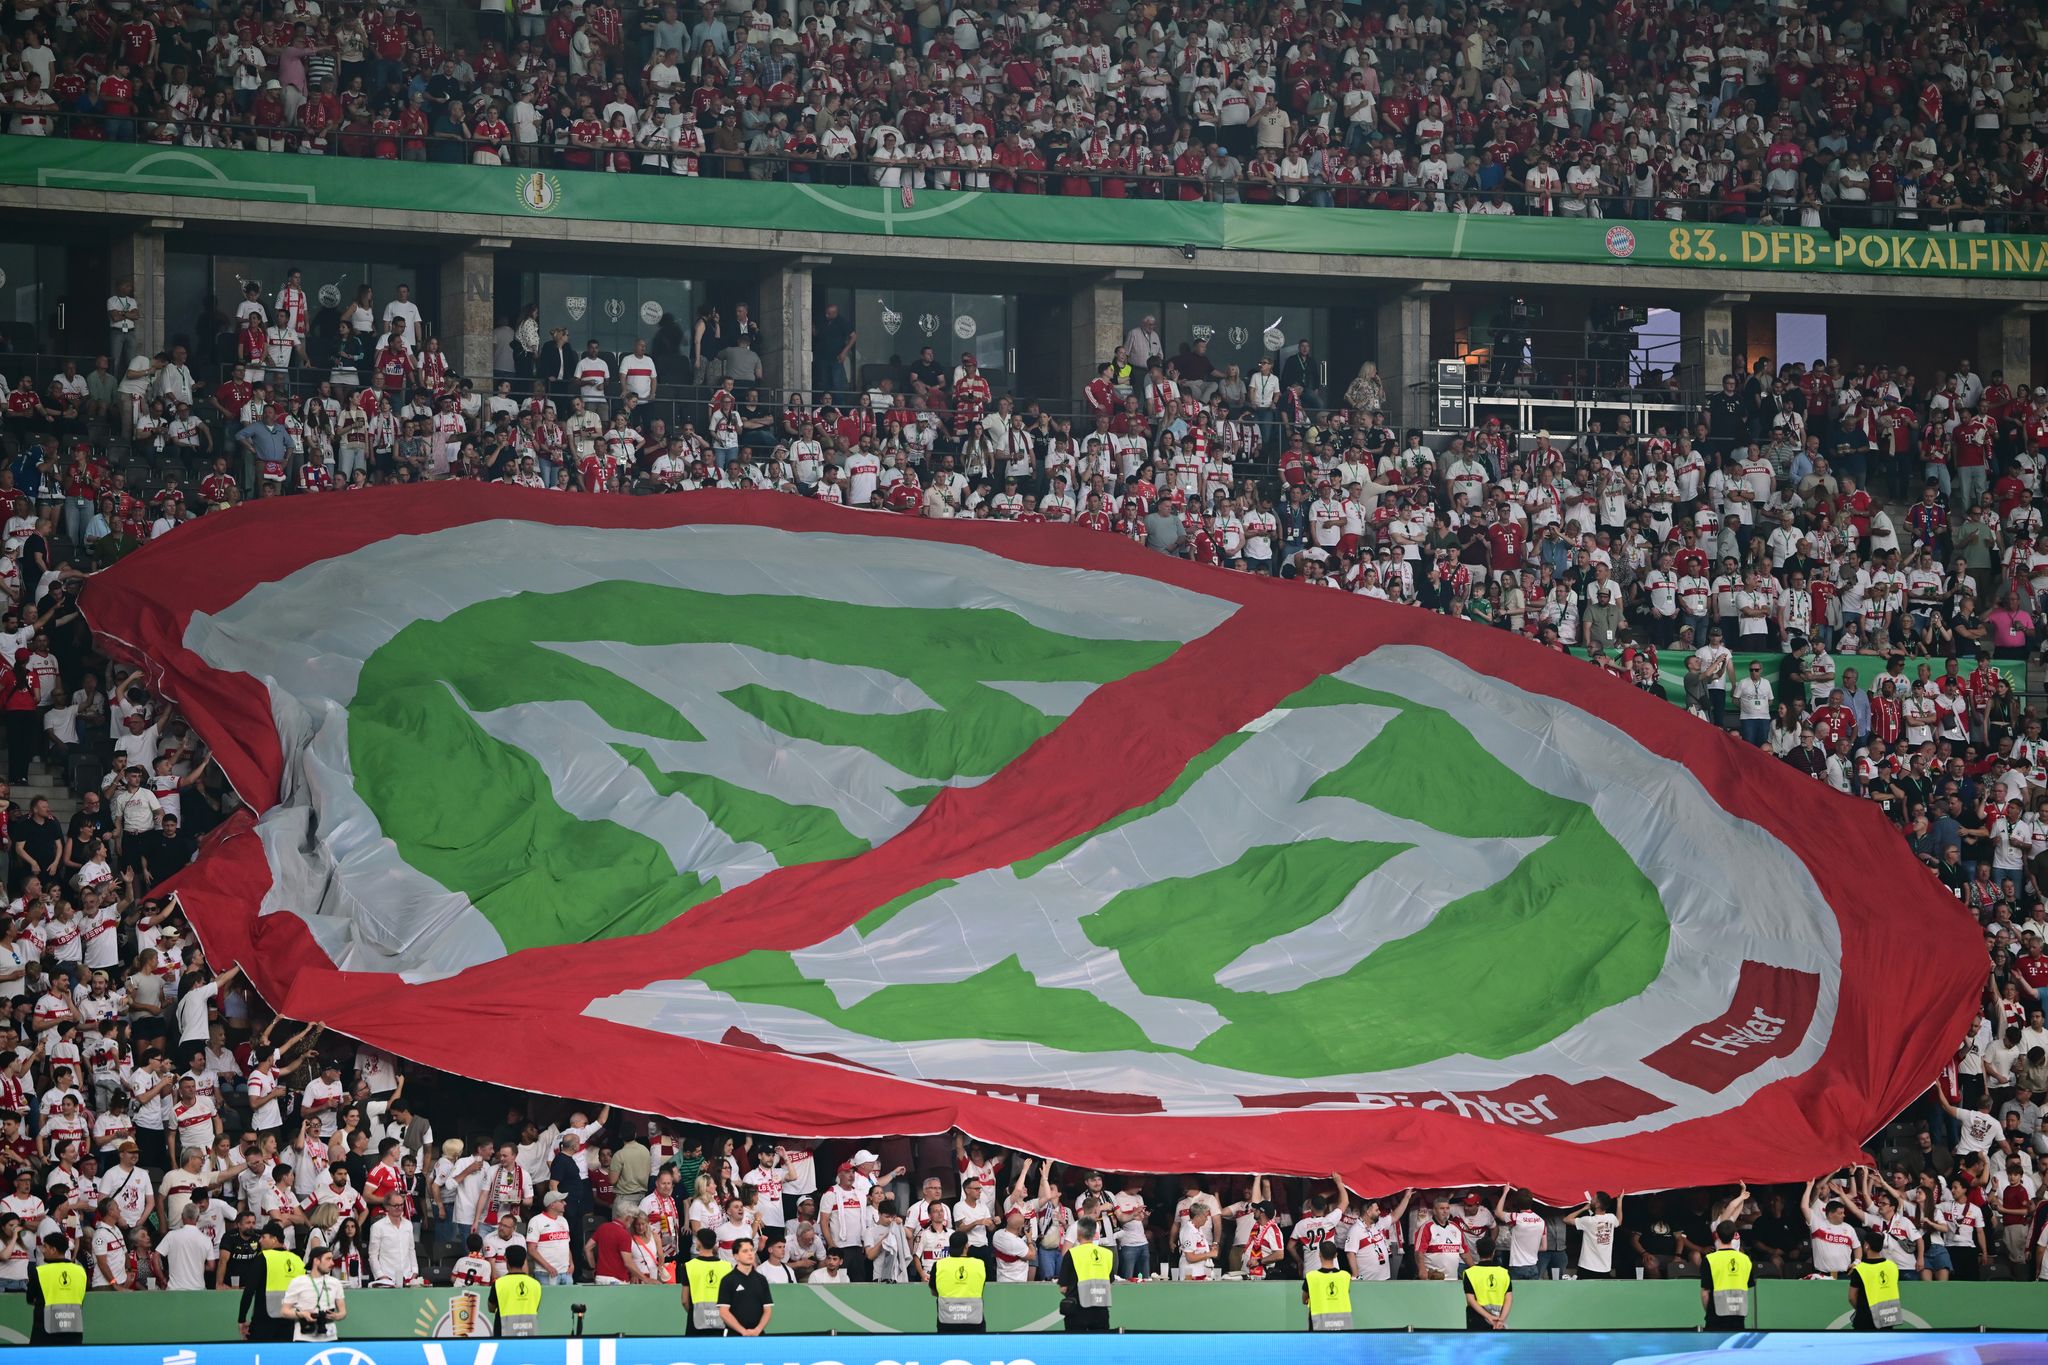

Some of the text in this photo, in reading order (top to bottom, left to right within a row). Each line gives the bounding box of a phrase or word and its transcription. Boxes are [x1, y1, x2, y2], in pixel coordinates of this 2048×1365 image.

[132, 36, 142, 47] T
[1669, 228, 1728, 262] 83.
[467, 272, 491, 302] N
[1708, 328, 1729, 355] N
[1830, 718, 1841, 730] T
[1307, 1228, 1326, 1251] 22
